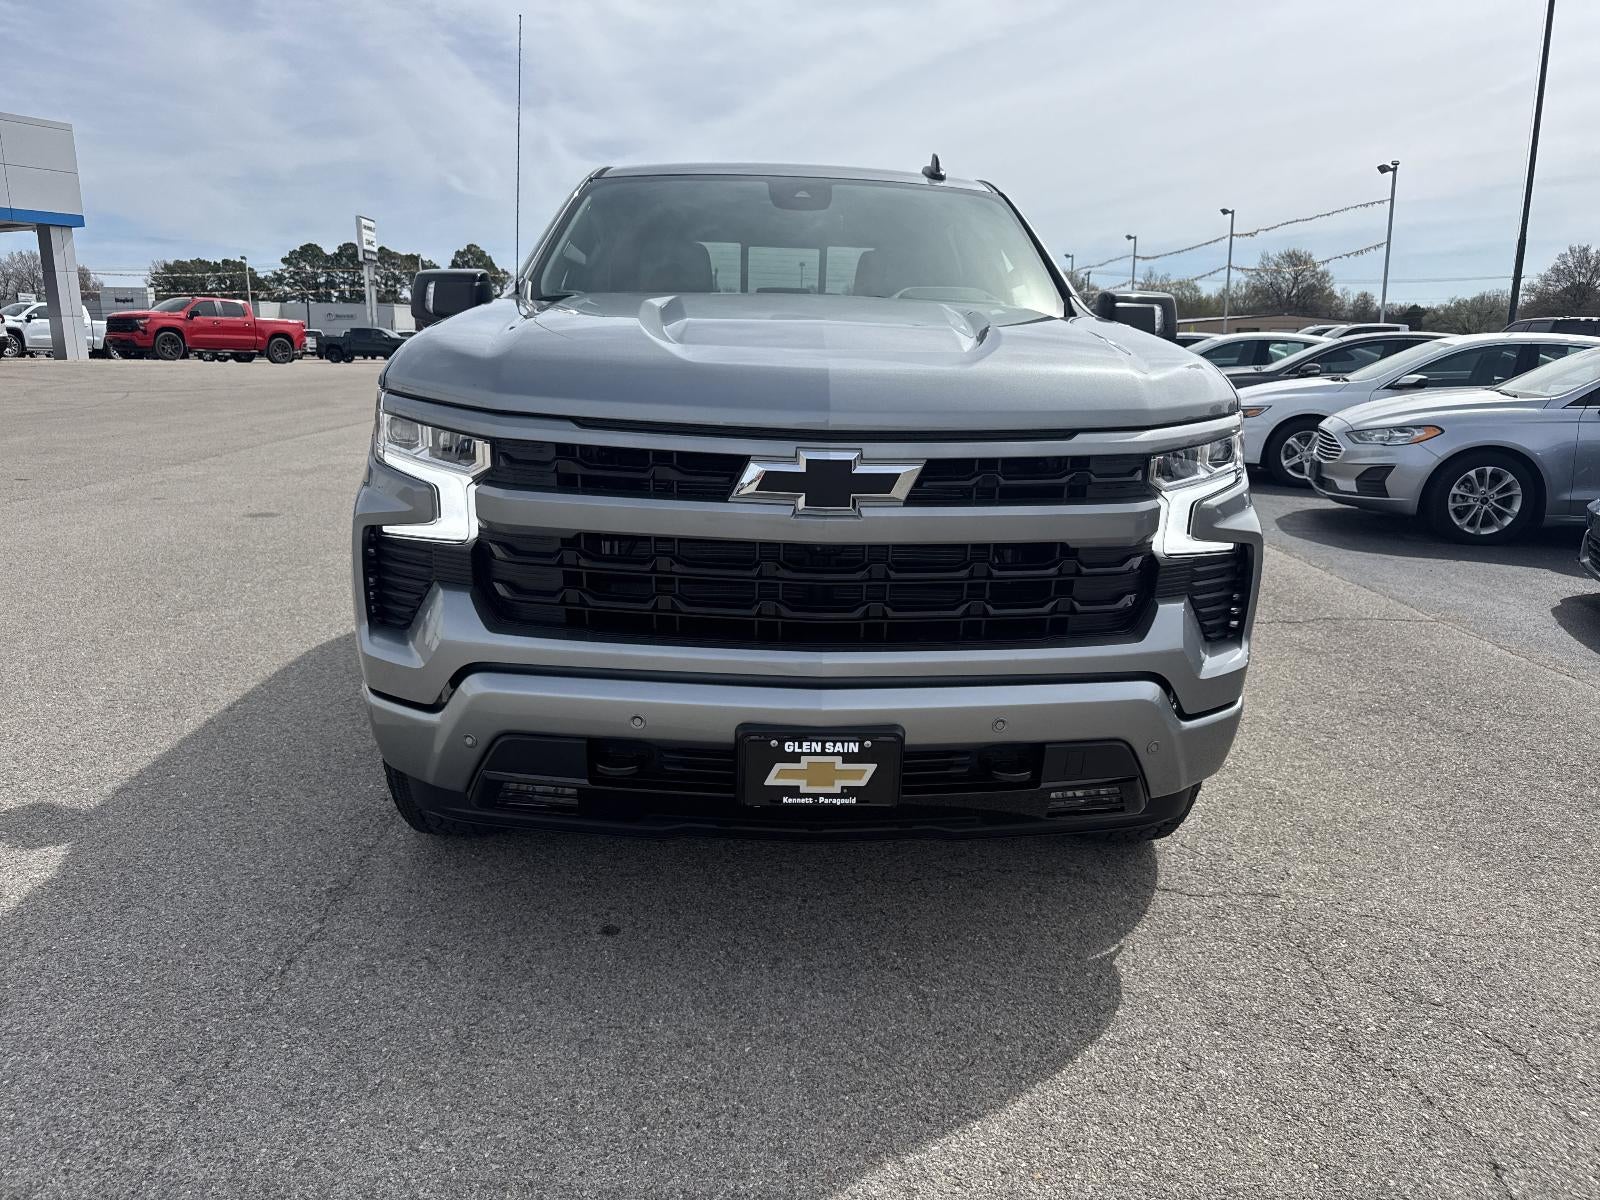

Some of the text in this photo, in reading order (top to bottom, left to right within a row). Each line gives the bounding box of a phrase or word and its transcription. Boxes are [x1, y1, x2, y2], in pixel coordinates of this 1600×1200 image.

[784, 741, 859, 753] GLEN SAIN
[782, 796, 813, 804] Kennett
[819, 796, 856, 806] Paragould
